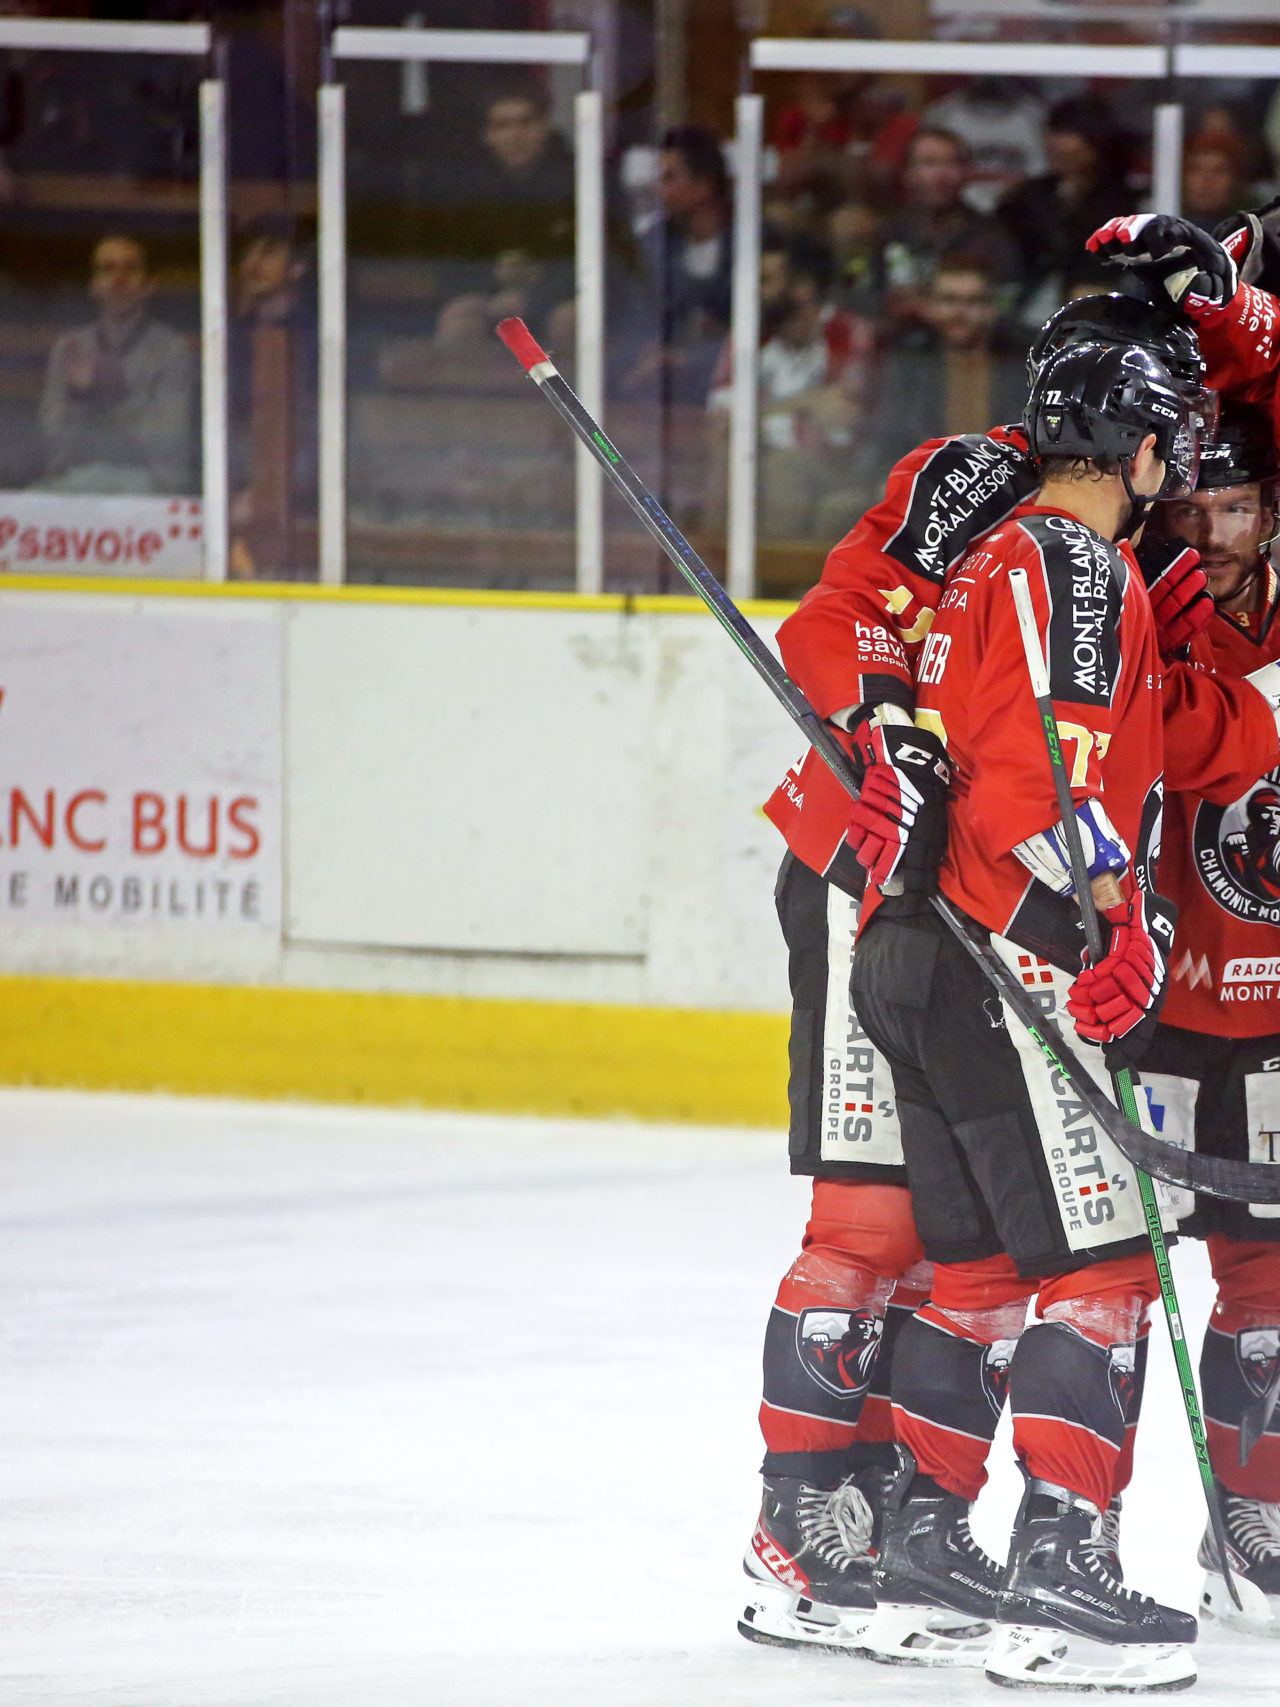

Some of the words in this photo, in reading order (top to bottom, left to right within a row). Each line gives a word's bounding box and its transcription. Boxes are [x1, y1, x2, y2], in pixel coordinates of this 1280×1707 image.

[1151, 402, 1179, 420] CCM
[966, 459, 1017, 508] RESORT
[1061, 533, 1097, 694] MONT-BLANC
[1236, 611, 1250, 627] 3
[857, 652, 869, 662] le
[1044, 714, 1062, 766] CCM
[0, 786, 108, 853] NC
[131, 790, 261, 859] BUS
[54, 873, 261, 917] MOBILITÉ
[1219, 985, 1274, 1002] MONT
[1028, 1026, 1071, 1080] CCM
[826, 1057, 842, 1142] GROUPE
[1050, 1146, 1083, 1232] GROUPE
[1184, 1386, 1210, 1466] CCM
